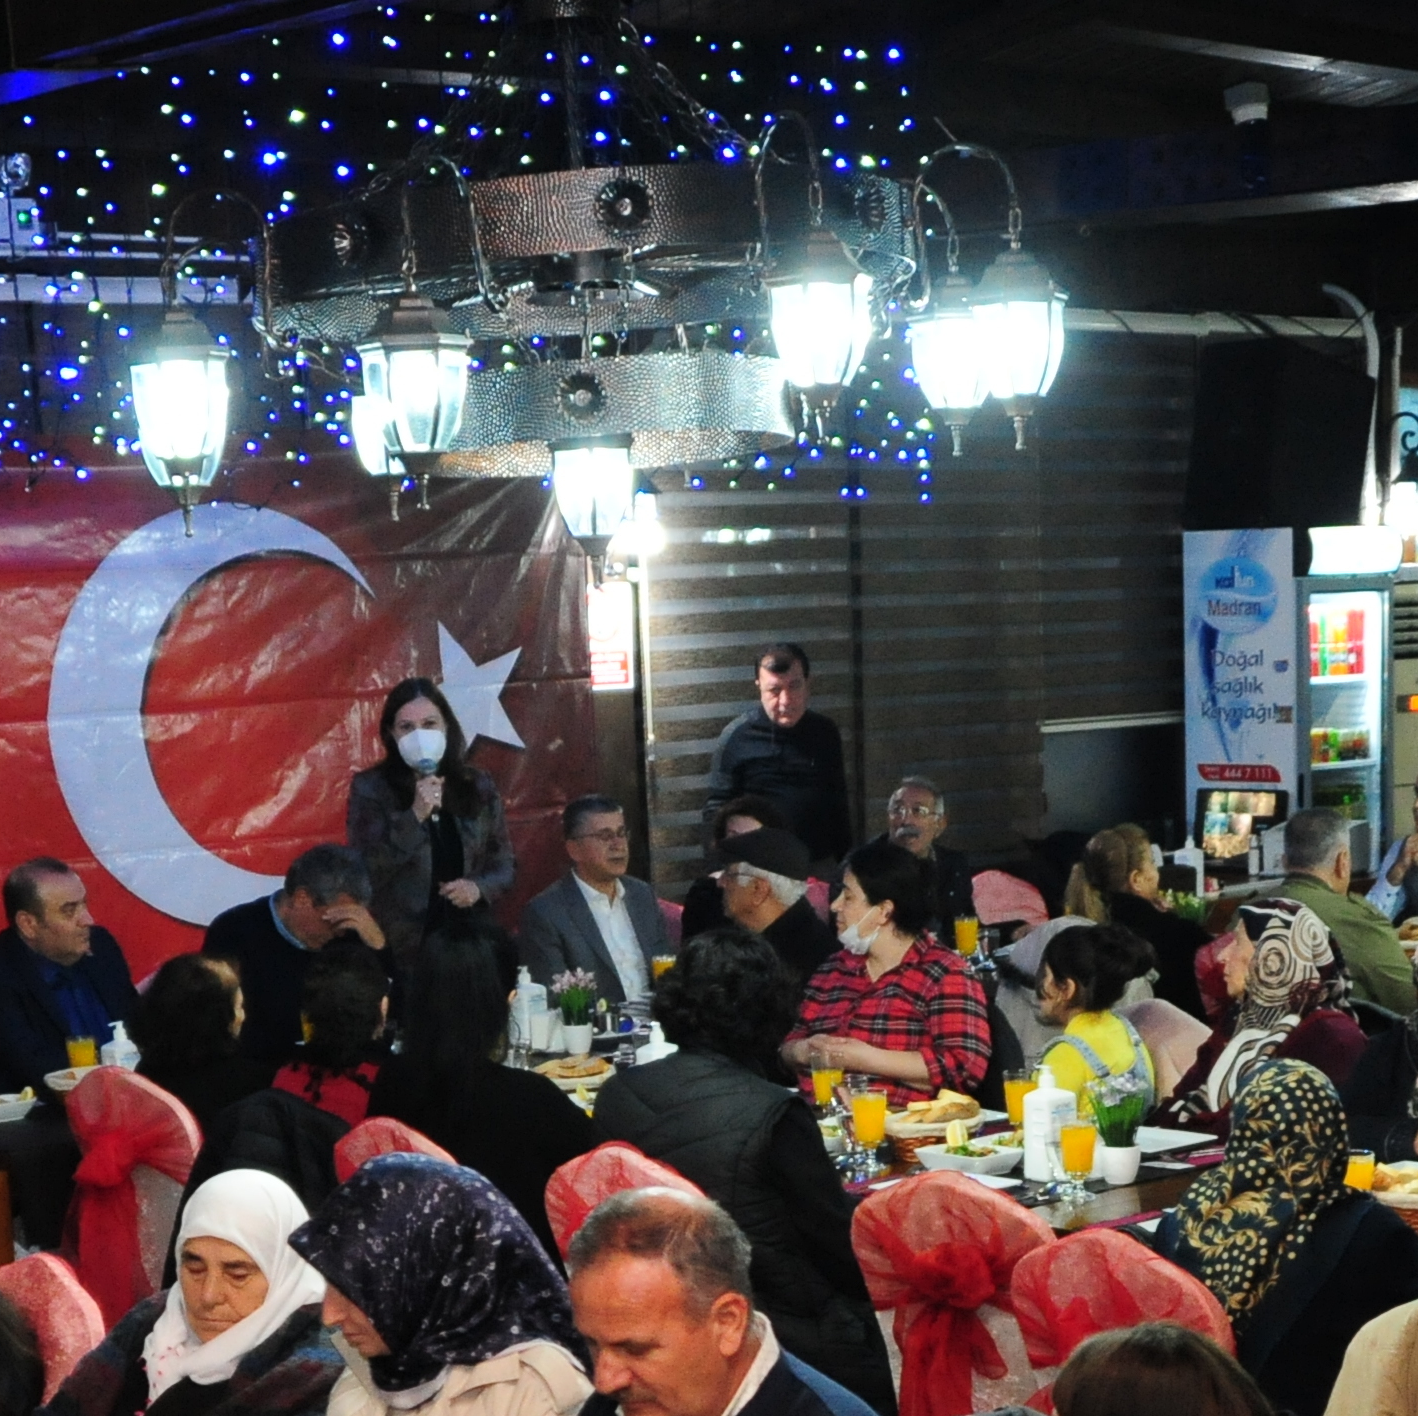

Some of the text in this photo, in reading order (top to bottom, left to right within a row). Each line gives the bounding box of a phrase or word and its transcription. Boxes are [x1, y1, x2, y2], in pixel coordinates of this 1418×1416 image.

[1207, 599, 1262, 616] Madran
[1212, 649, 1264, 671] Doğal
[1213, 676, 1264, 699] sağlık
[1224, 767, 1242, 779] 444
